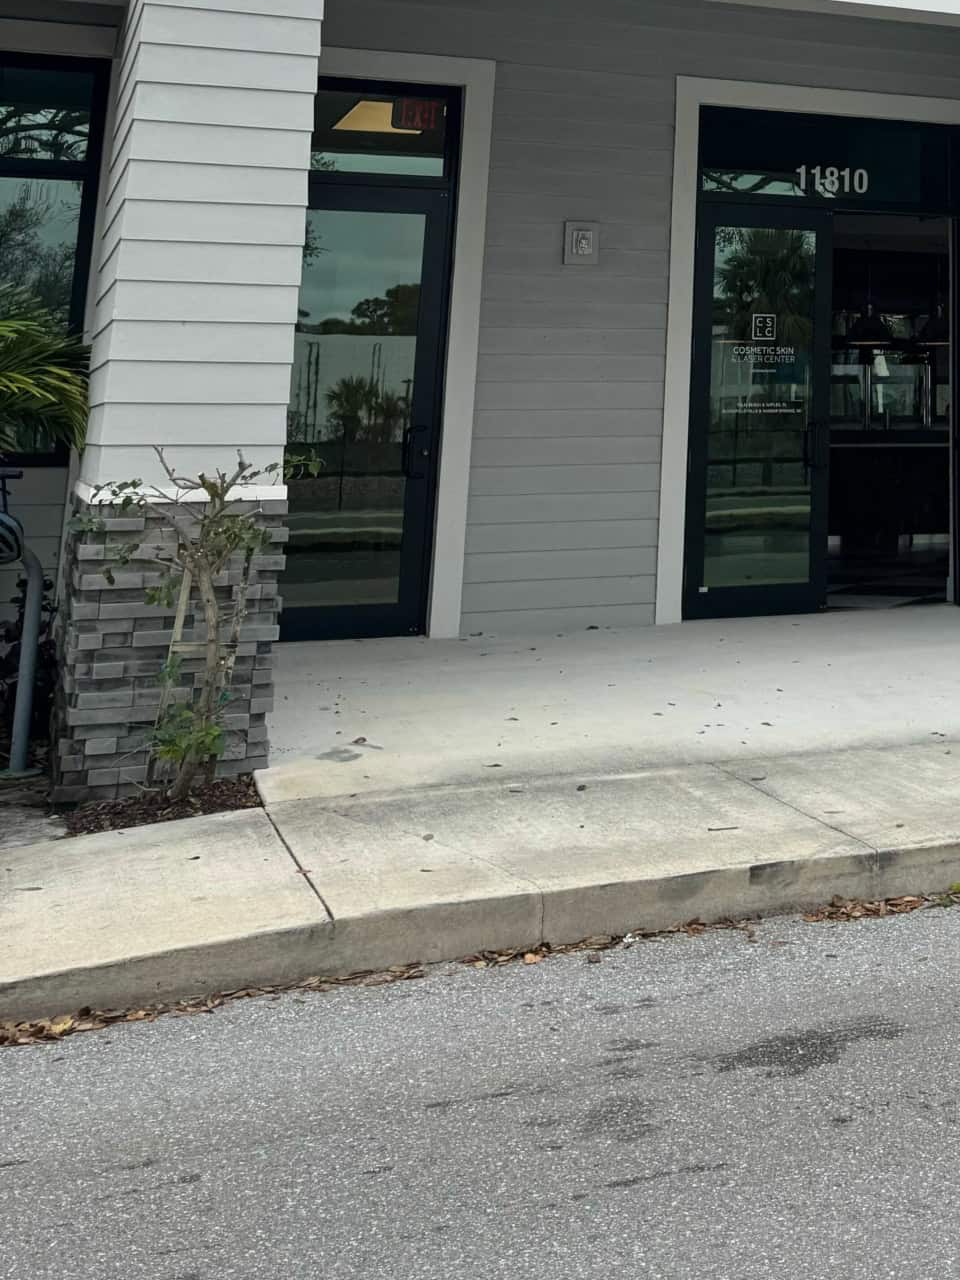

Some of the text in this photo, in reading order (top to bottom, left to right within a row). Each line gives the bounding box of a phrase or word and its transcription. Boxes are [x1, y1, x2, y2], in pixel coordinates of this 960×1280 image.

[796, 165, 869, 194] 11810
[733, 346, 794, 355] COSMETIC SKIN
[737, 355, 763, 363] LASER
[764, 355, 796, 363] CENTER
